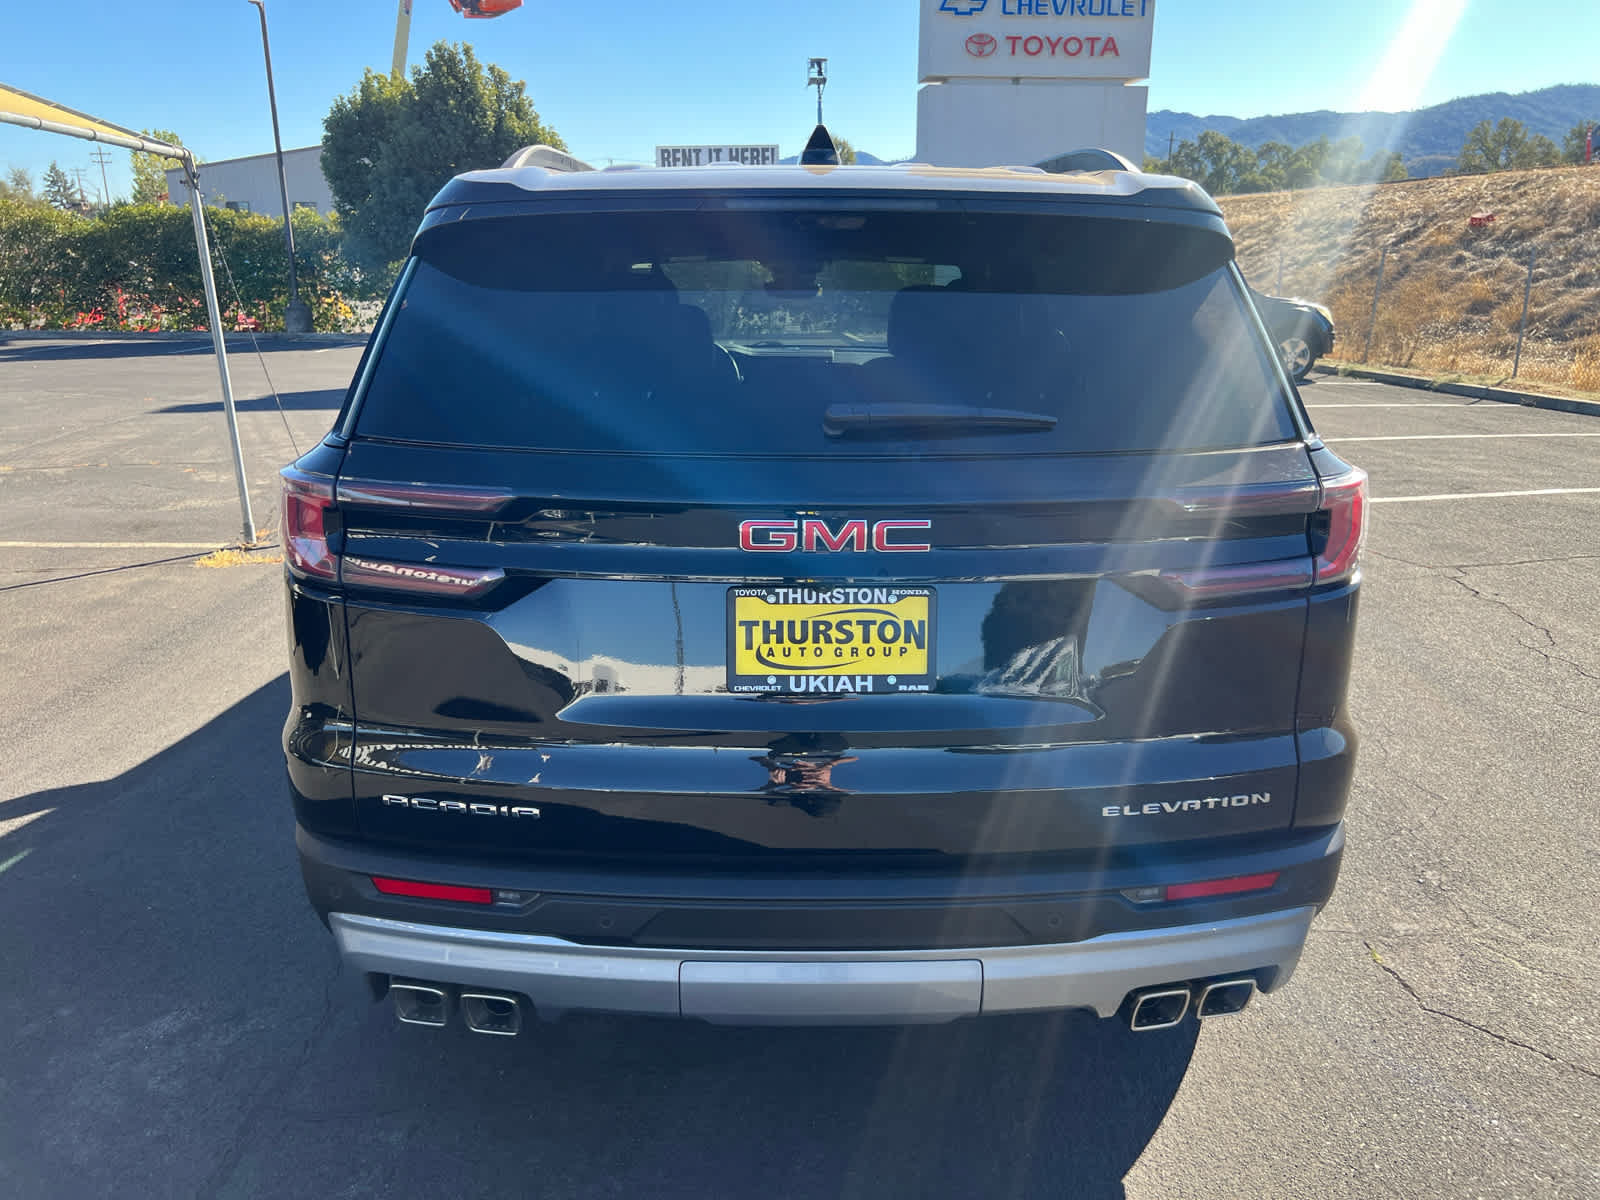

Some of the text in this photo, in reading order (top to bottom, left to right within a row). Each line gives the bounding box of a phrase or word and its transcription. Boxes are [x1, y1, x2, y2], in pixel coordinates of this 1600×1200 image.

[1001, 0, 1148, 17] CHEVROLET
[1005, 35, 1120, 57] TOYOTA
[660, 148, 701, 168] RENT
[708, 147, 722, 163] IT
[739, 519, 932, 553] GMC
[734, 589, 768, 597] TOYOTA
[775, 588, 887, 604] THURSTON
[738, 619, 926, 651] THURSTON
[766, 646, 909, 658] AUTO GROUP
[789, 675, 873, 693] UKIAH
[382, 794, 541, 819] ACADIA
[1101, 792, 1272, 818] ELEVATION
